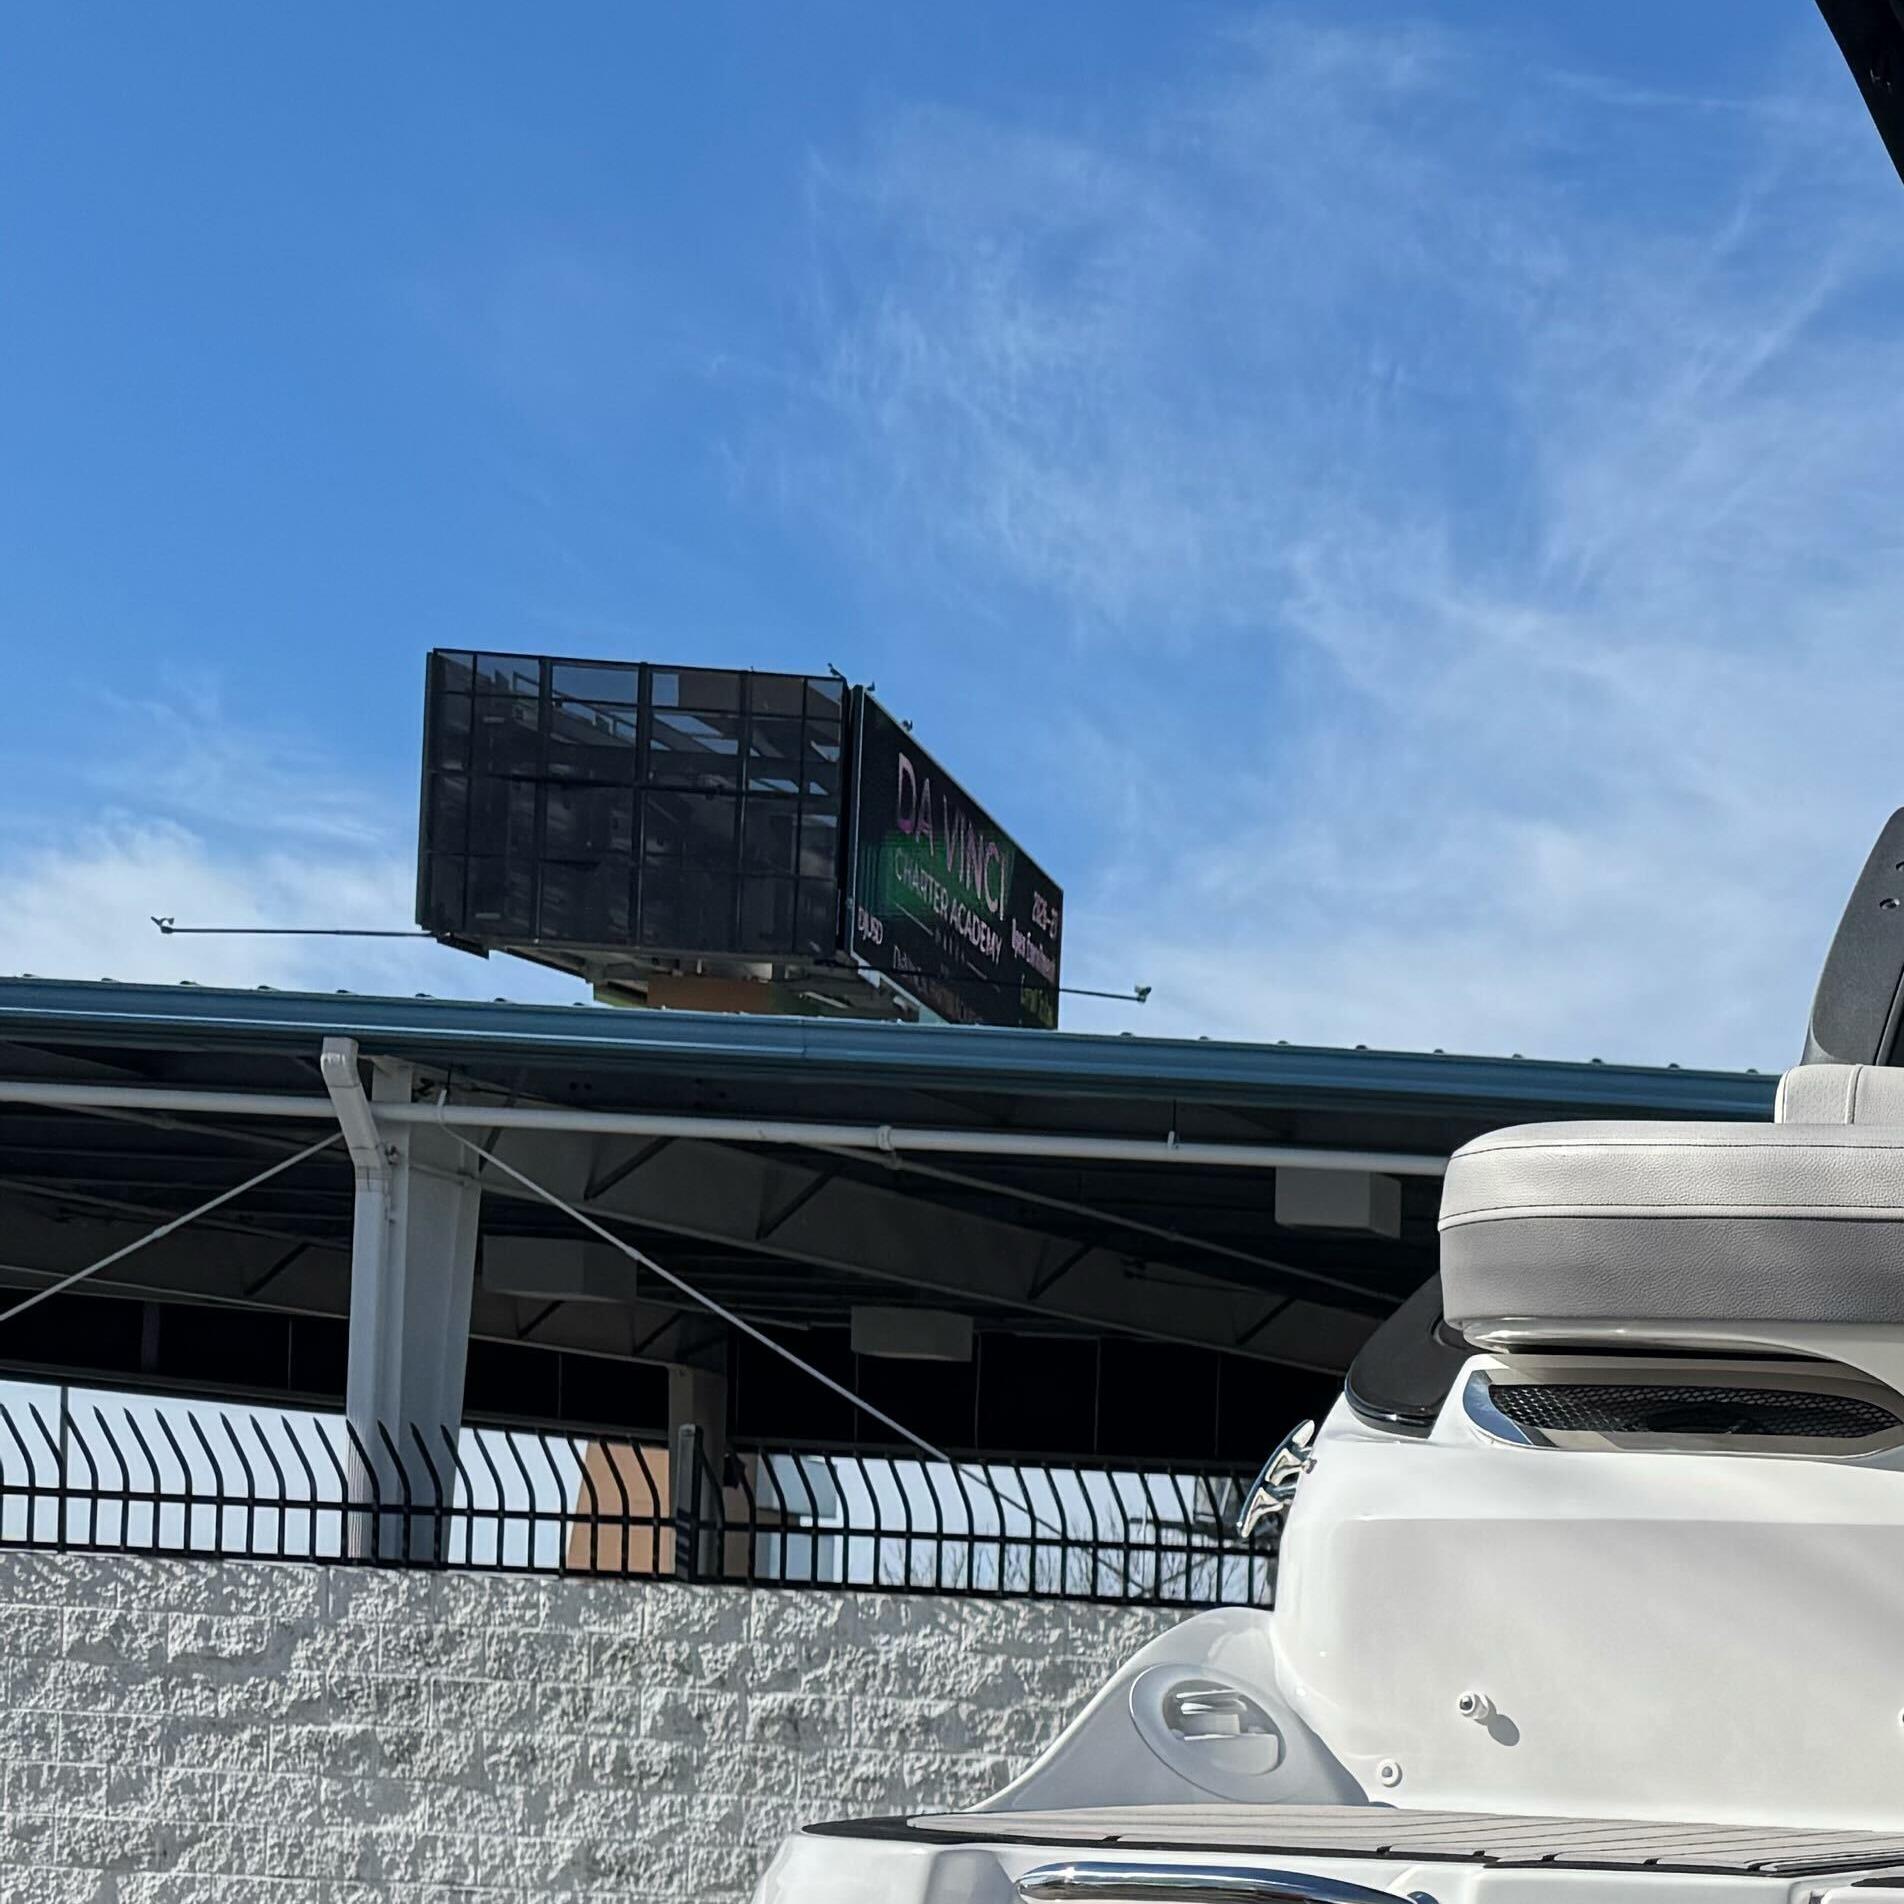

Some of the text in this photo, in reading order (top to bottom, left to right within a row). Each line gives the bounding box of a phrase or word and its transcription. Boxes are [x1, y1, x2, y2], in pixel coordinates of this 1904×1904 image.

[895, 847, 949, 923] CHARTER
[949, 898, 1003, 965] ACADEMY
[897, 752, 1005, 921] DA VINCI
